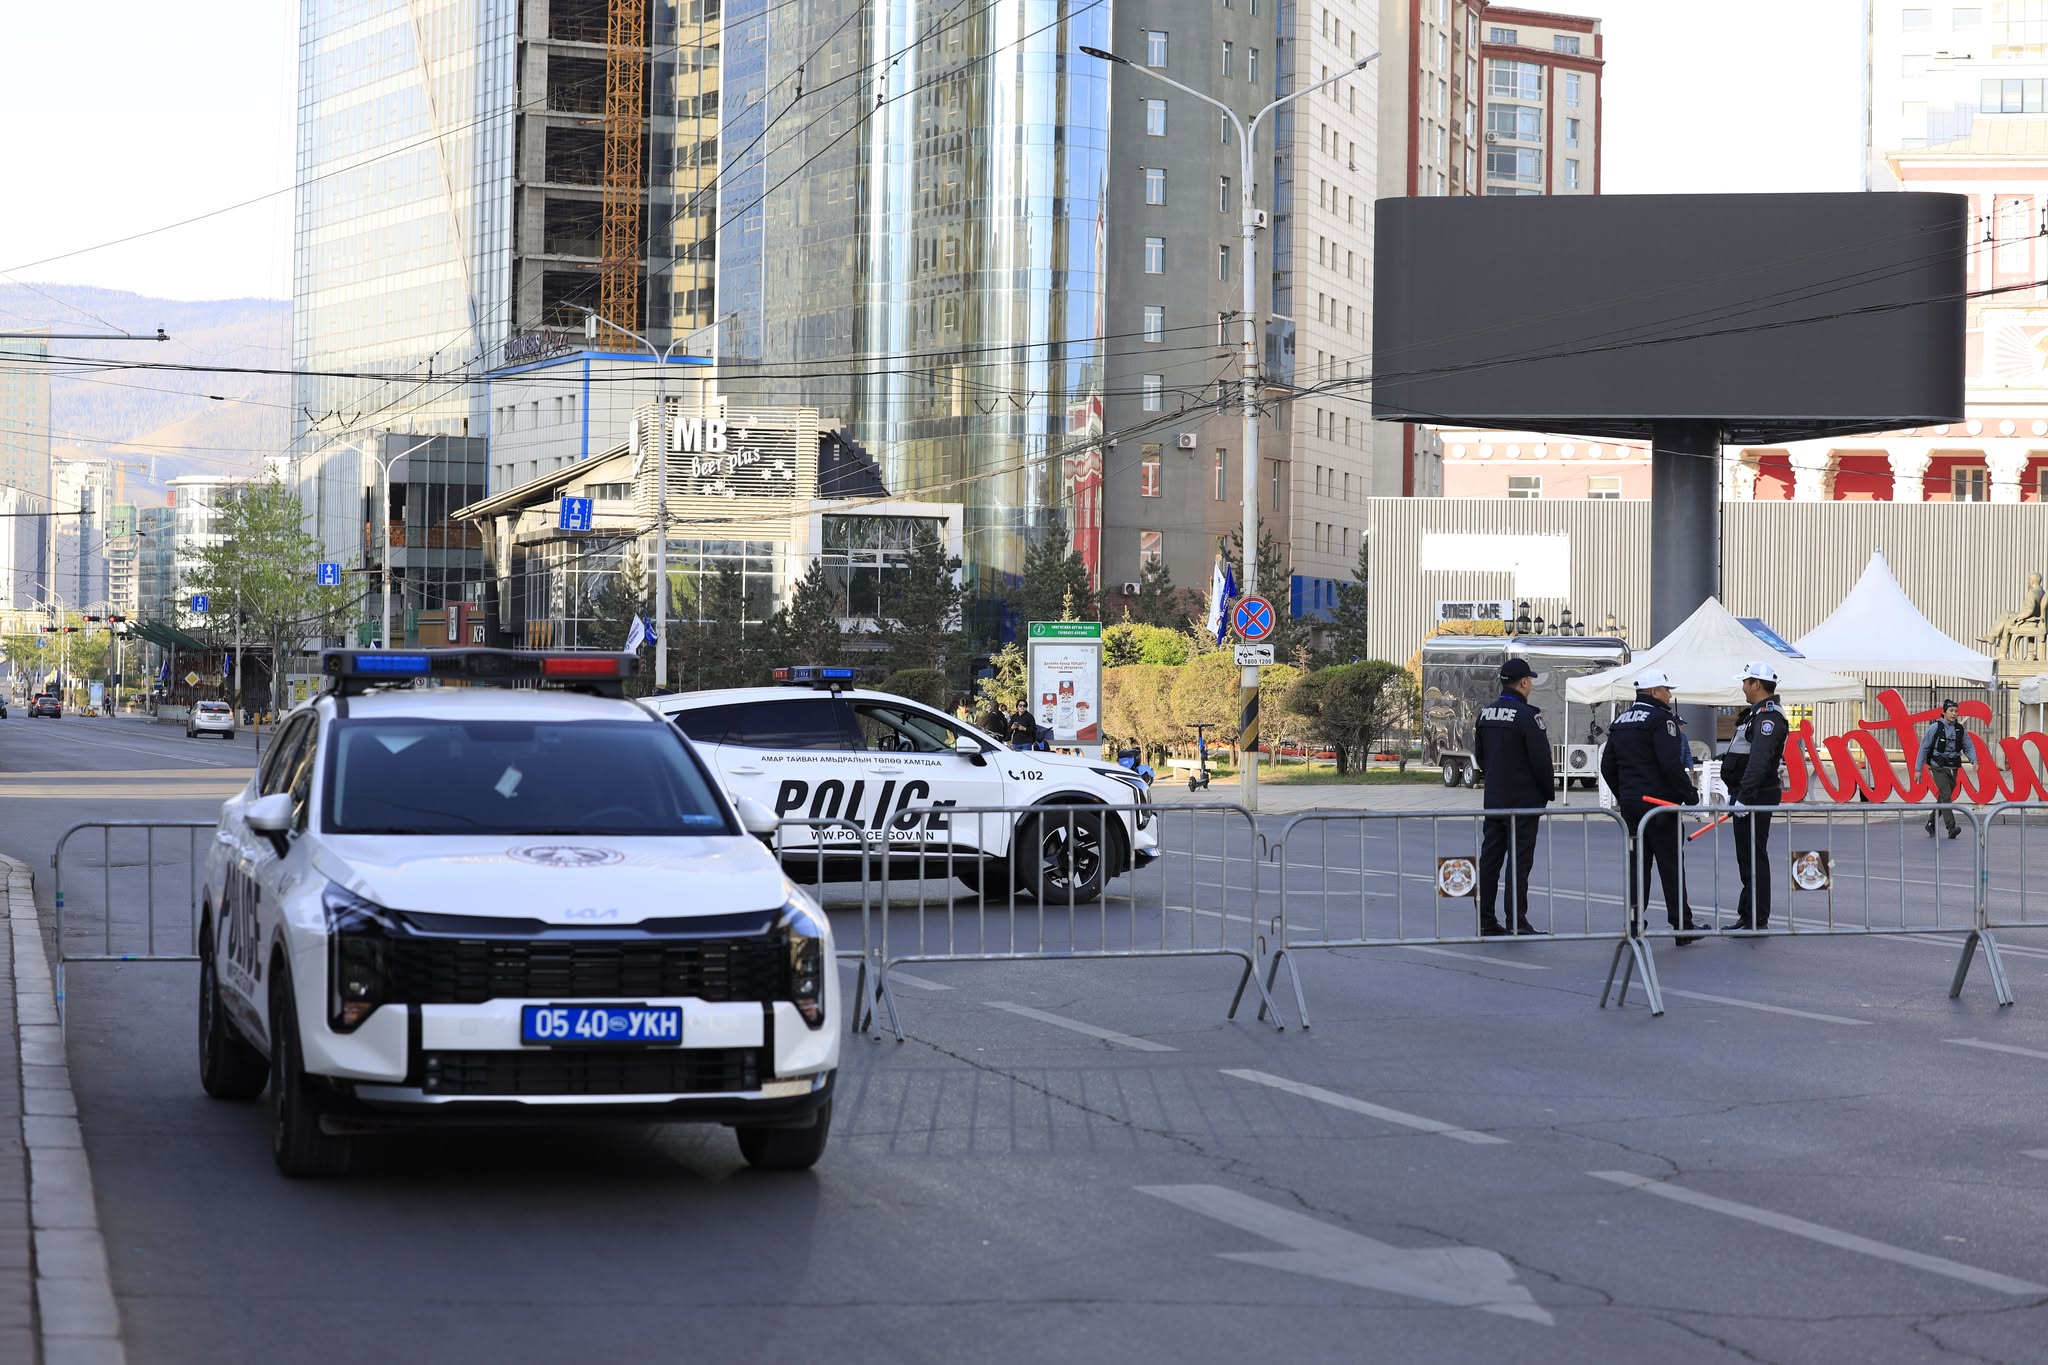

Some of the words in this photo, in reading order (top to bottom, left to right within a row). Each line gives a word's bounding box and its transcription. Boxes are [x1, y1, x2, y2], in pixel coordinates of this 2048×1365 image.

[672, 417, 728, 452] MB
[728, 446, 761, 475] plus
[1441, 603, 1474, 619] STREET
[1477, 603, 1503, 619] CAFE
[1479, 707, 1518, 722] POLICE
[1614, 711, 1650, 725] POLICE
[904, 758, 942, 767] ХАМТДАА
[1020, 770, 1044, 781] 102
[535, 1009, 569, 1038] 05
[575, 1009, 609, 1038] 40
[628, 1011, 677, 1037] УКН
